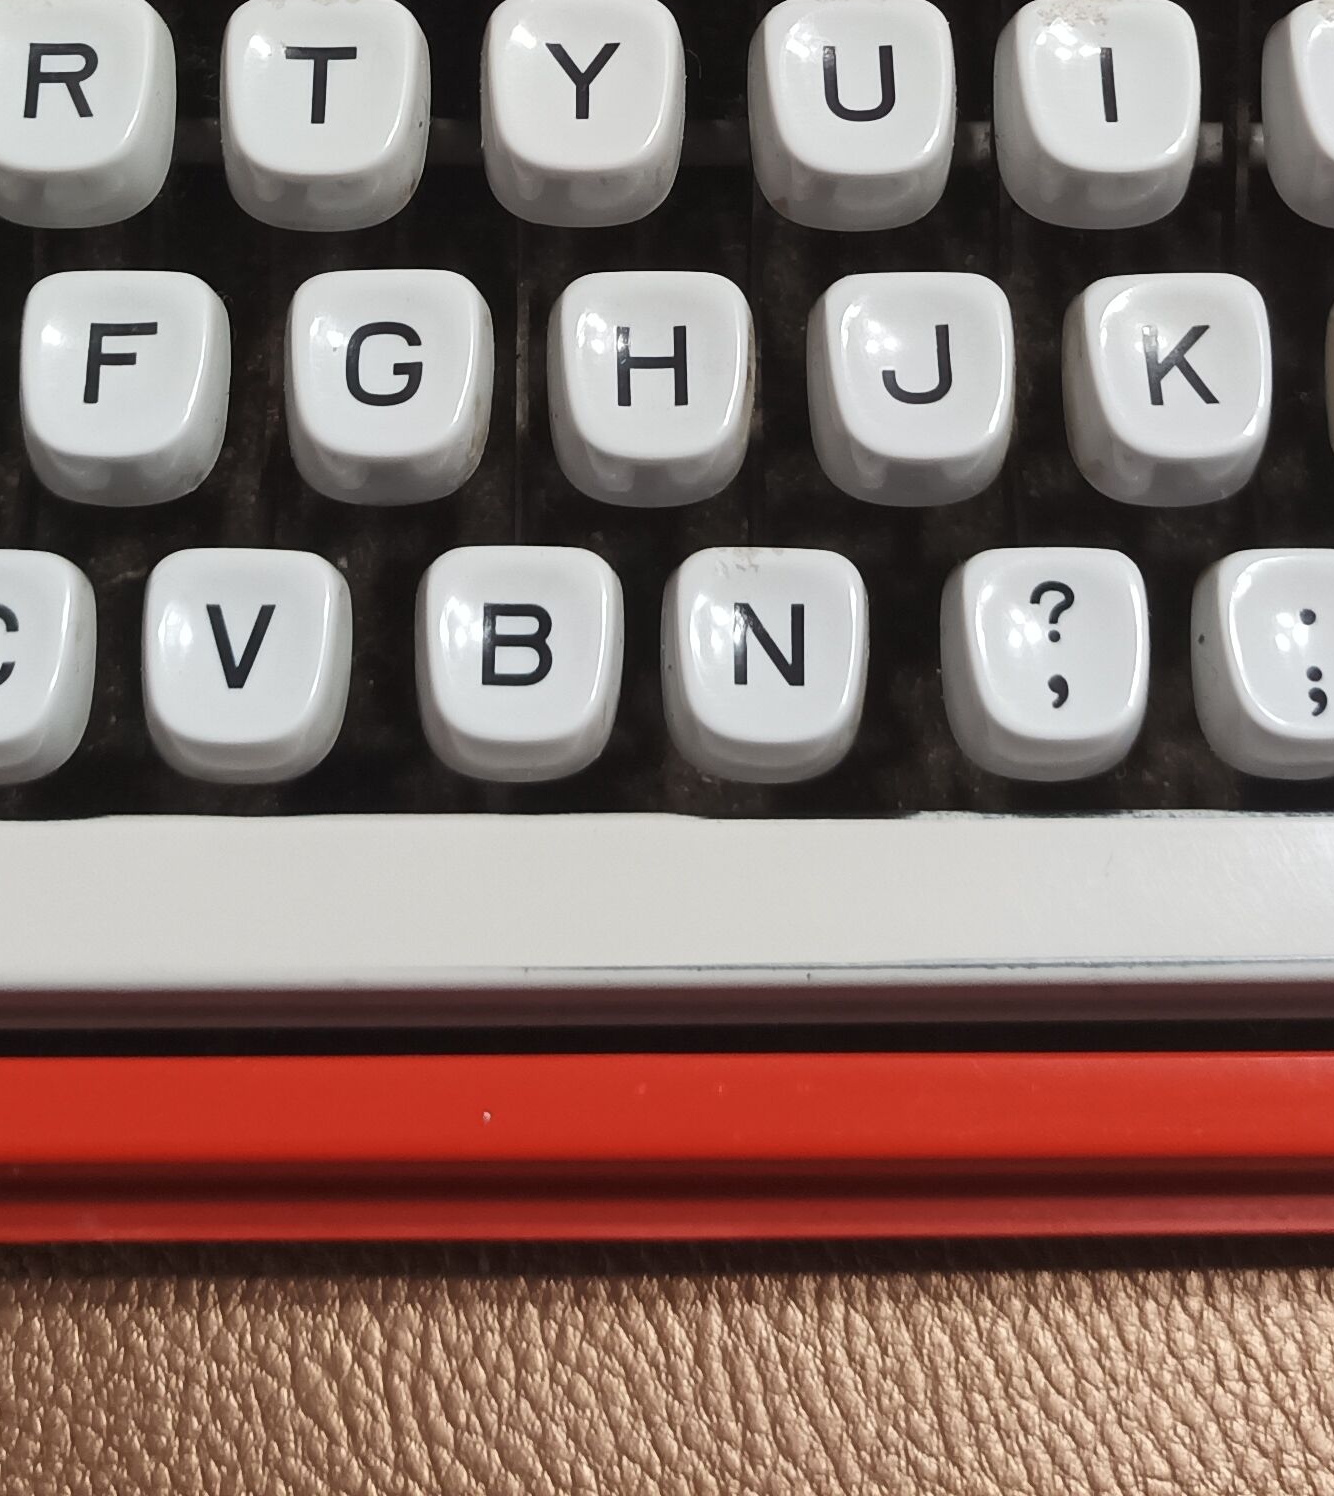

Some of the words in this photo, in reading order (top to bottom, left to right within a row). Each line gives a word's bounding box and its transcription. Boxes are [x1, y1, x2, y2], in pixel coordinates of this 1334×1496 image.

[24, 43, 98, 118] R
[285, 47, 357, 124] T
[546, 43, 620, 119] Y
[823, 45, 895, 121] U
[1101, 48, 1118, 122] I
[84, 322, 157, 404] F
[346, 322, 423, 406] G
[617, 326, 688, 406] H
[882, 324, 952, 404] J
[1141, 324, 1220, 406] K
[206, 604, 275, 688] V
[482, 603, 552, 686] B
[734, 603, 804, 686] N
[1030, 581, 1074, 642] ?
